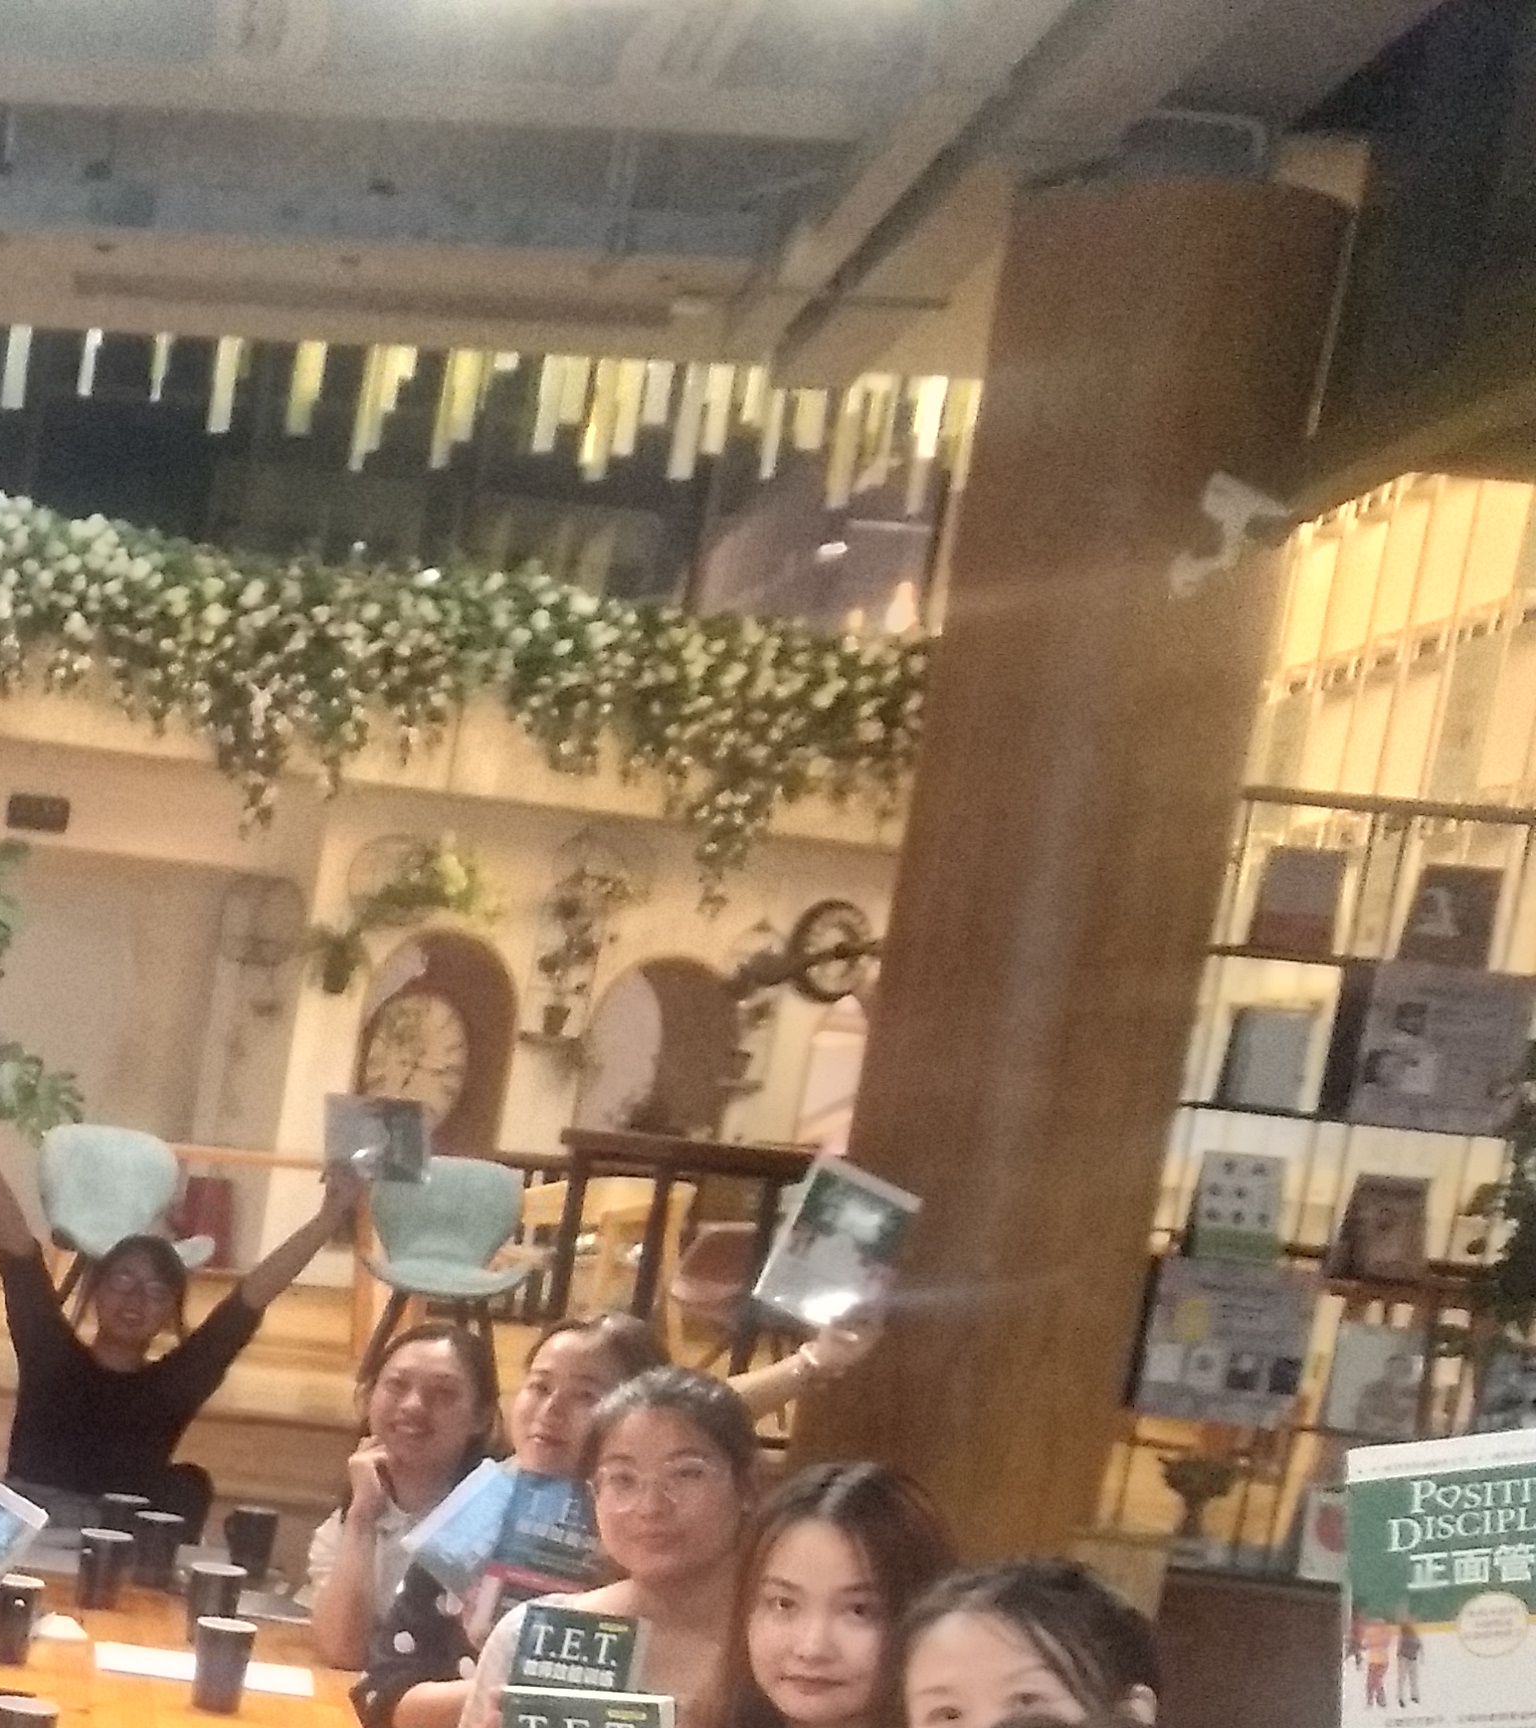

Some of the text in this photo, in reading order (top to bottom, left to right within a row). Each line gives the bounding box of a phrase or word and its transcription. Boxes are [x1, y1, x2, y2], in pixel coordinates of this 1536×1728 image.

[1407, 1542, 1536, 1590] 正面管
[532, 1623, 619, 1668] T.E.T.
